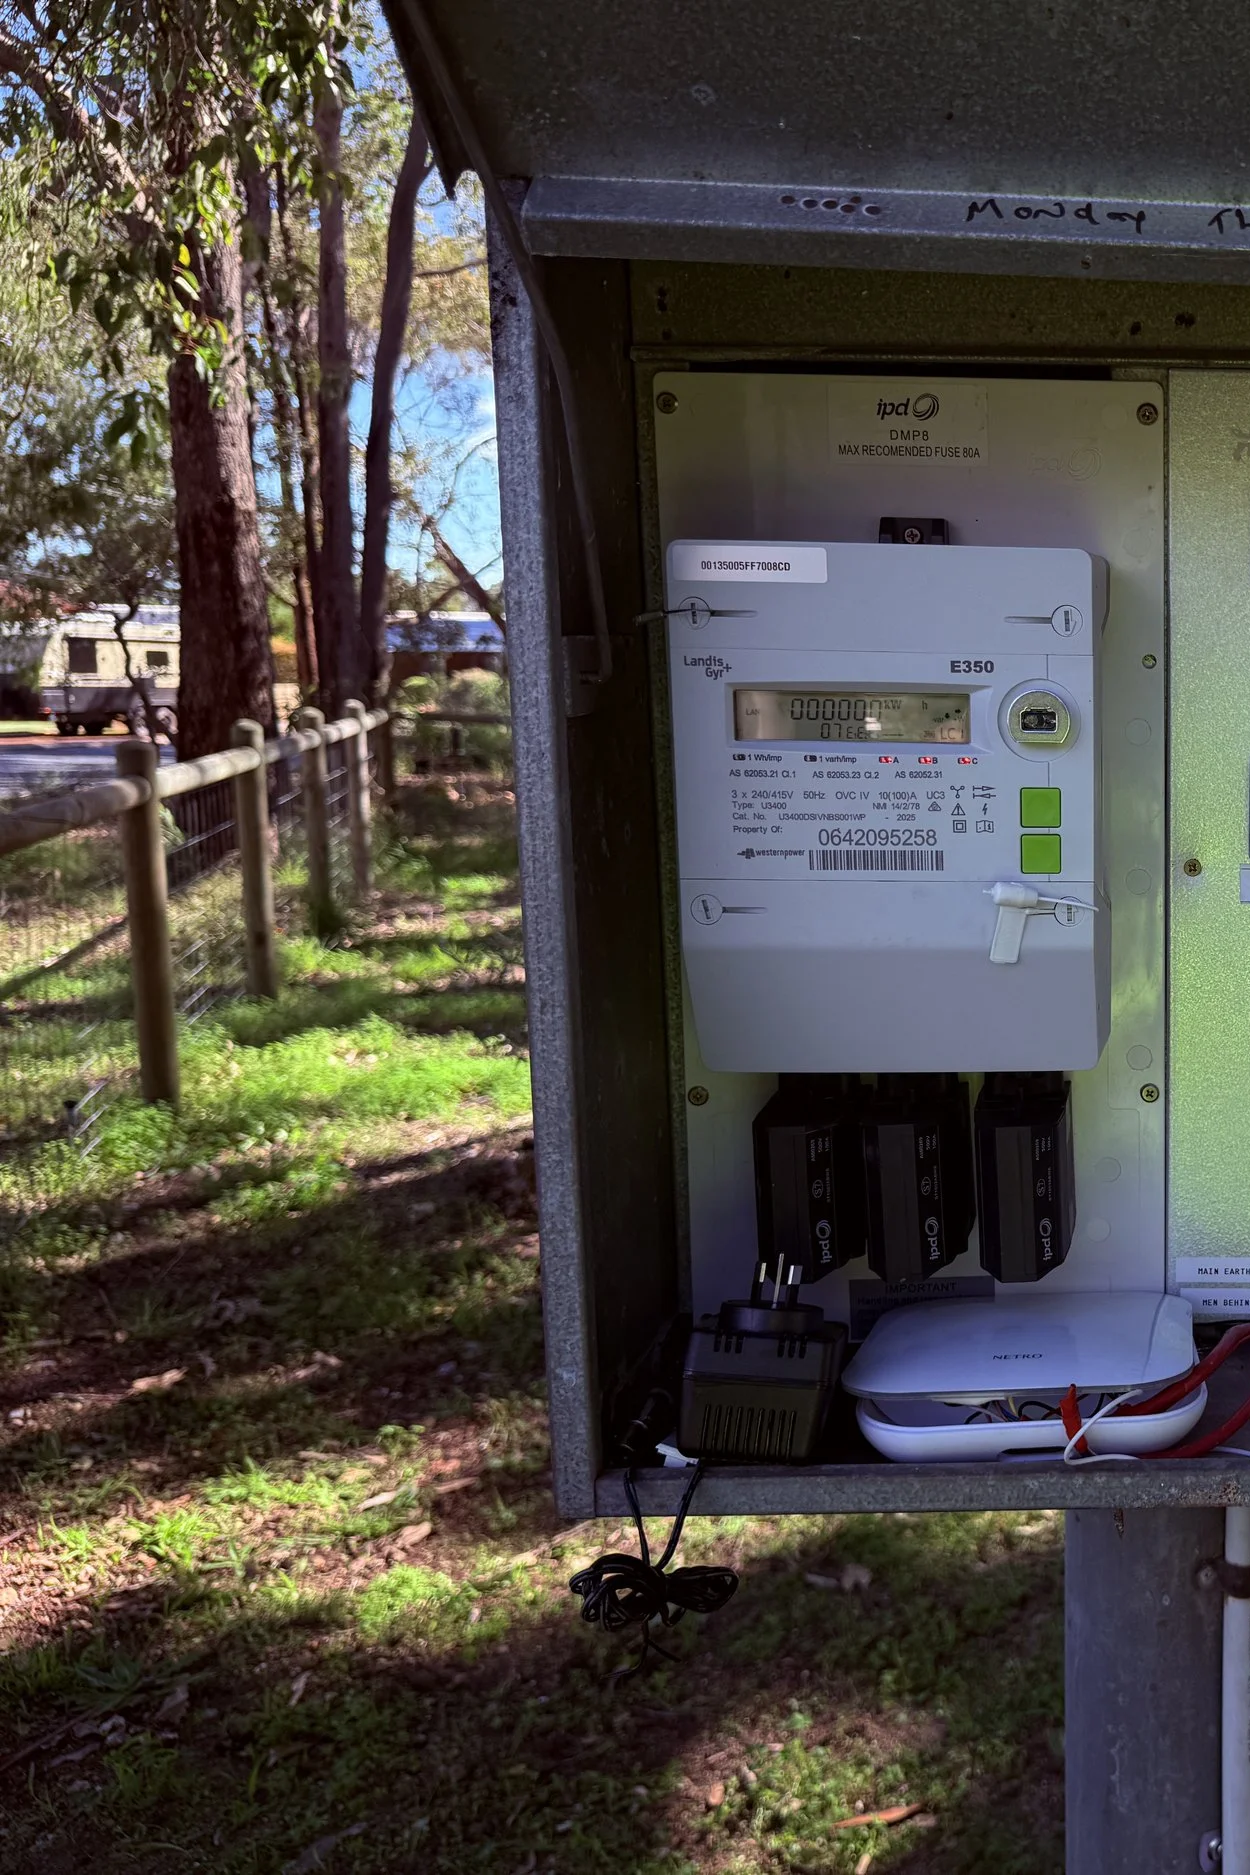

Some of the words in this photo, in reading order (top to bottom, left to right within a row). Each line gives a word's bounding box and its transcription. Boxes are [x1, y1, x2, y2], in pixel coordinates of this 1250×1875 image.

[965, 199, 1146, 235] Monday
[876, 397, 910, 420] ipd
[889, 429, 929, 441] DMP8
[838, 444, 860, 456] MAX
[862, 445, 933, 457] RECOMENDED
[935, 446, 961, 458] FUSE
[962, 447, 981, 459] 80A
[700, 559, 791, 572] 00135005FF7008CD
[683, 655, 724, 667] Landis
[949, 660, 995, 674] E350
[753, 753, 783, 763] Wh/imp
[825, 755, 857, 765] varh/imp
[893, 756, 899, 764] A
[972, 757, 978, 765] C
[729, 769, 741, 777] AS
[743, 769, 779, 778] 62053.21
[812, 771, 824, 779] AS
[826, 771, 861, 779] 62053.23
[908, 771, 943, 779] 62052.31
[731, 789, 738, 799] 3
[751, 790, 794, 800] 240/415V
[803, 790, 826, 800] 50Hz
[835, 791, 856, 800] OVC
[859, 791, 870, 800] IV
[878, 791, 917, 801] 10(100)A
[926, 791, 945, 800] UC3
[731, 801, 755, 811] Type:
[761, 802, 787, 810] U3400
[872, 802, 887, 810] NMI
[891, 802, 920, 811] 14/2/78
[732, 812, 750, 821] Cat.
[753, 812, 767, 821] No.
[896, 813, 916, 821] 2025
[732, 825, 768, 835] Property
[771, 825, 783, 834] Of:
[818, 828, 938, 846] 0642095258
[755, 849, 805, 860] westernpower
[820, 1239, 831, 1264] ipd
[929, 1234, 940, 1260] ipd
[1042, 1235, 1053, 1261] ipd
[1197, 1267, 1220, 1275] MAIN
[1223, 1267, 1250, 1275] EARTH
[885, 1281, 957, 1294] IMPORTANT
[1202, 1298, 1220, 1307] MEN
[992, 1352, 1043, 1361] NETRO
